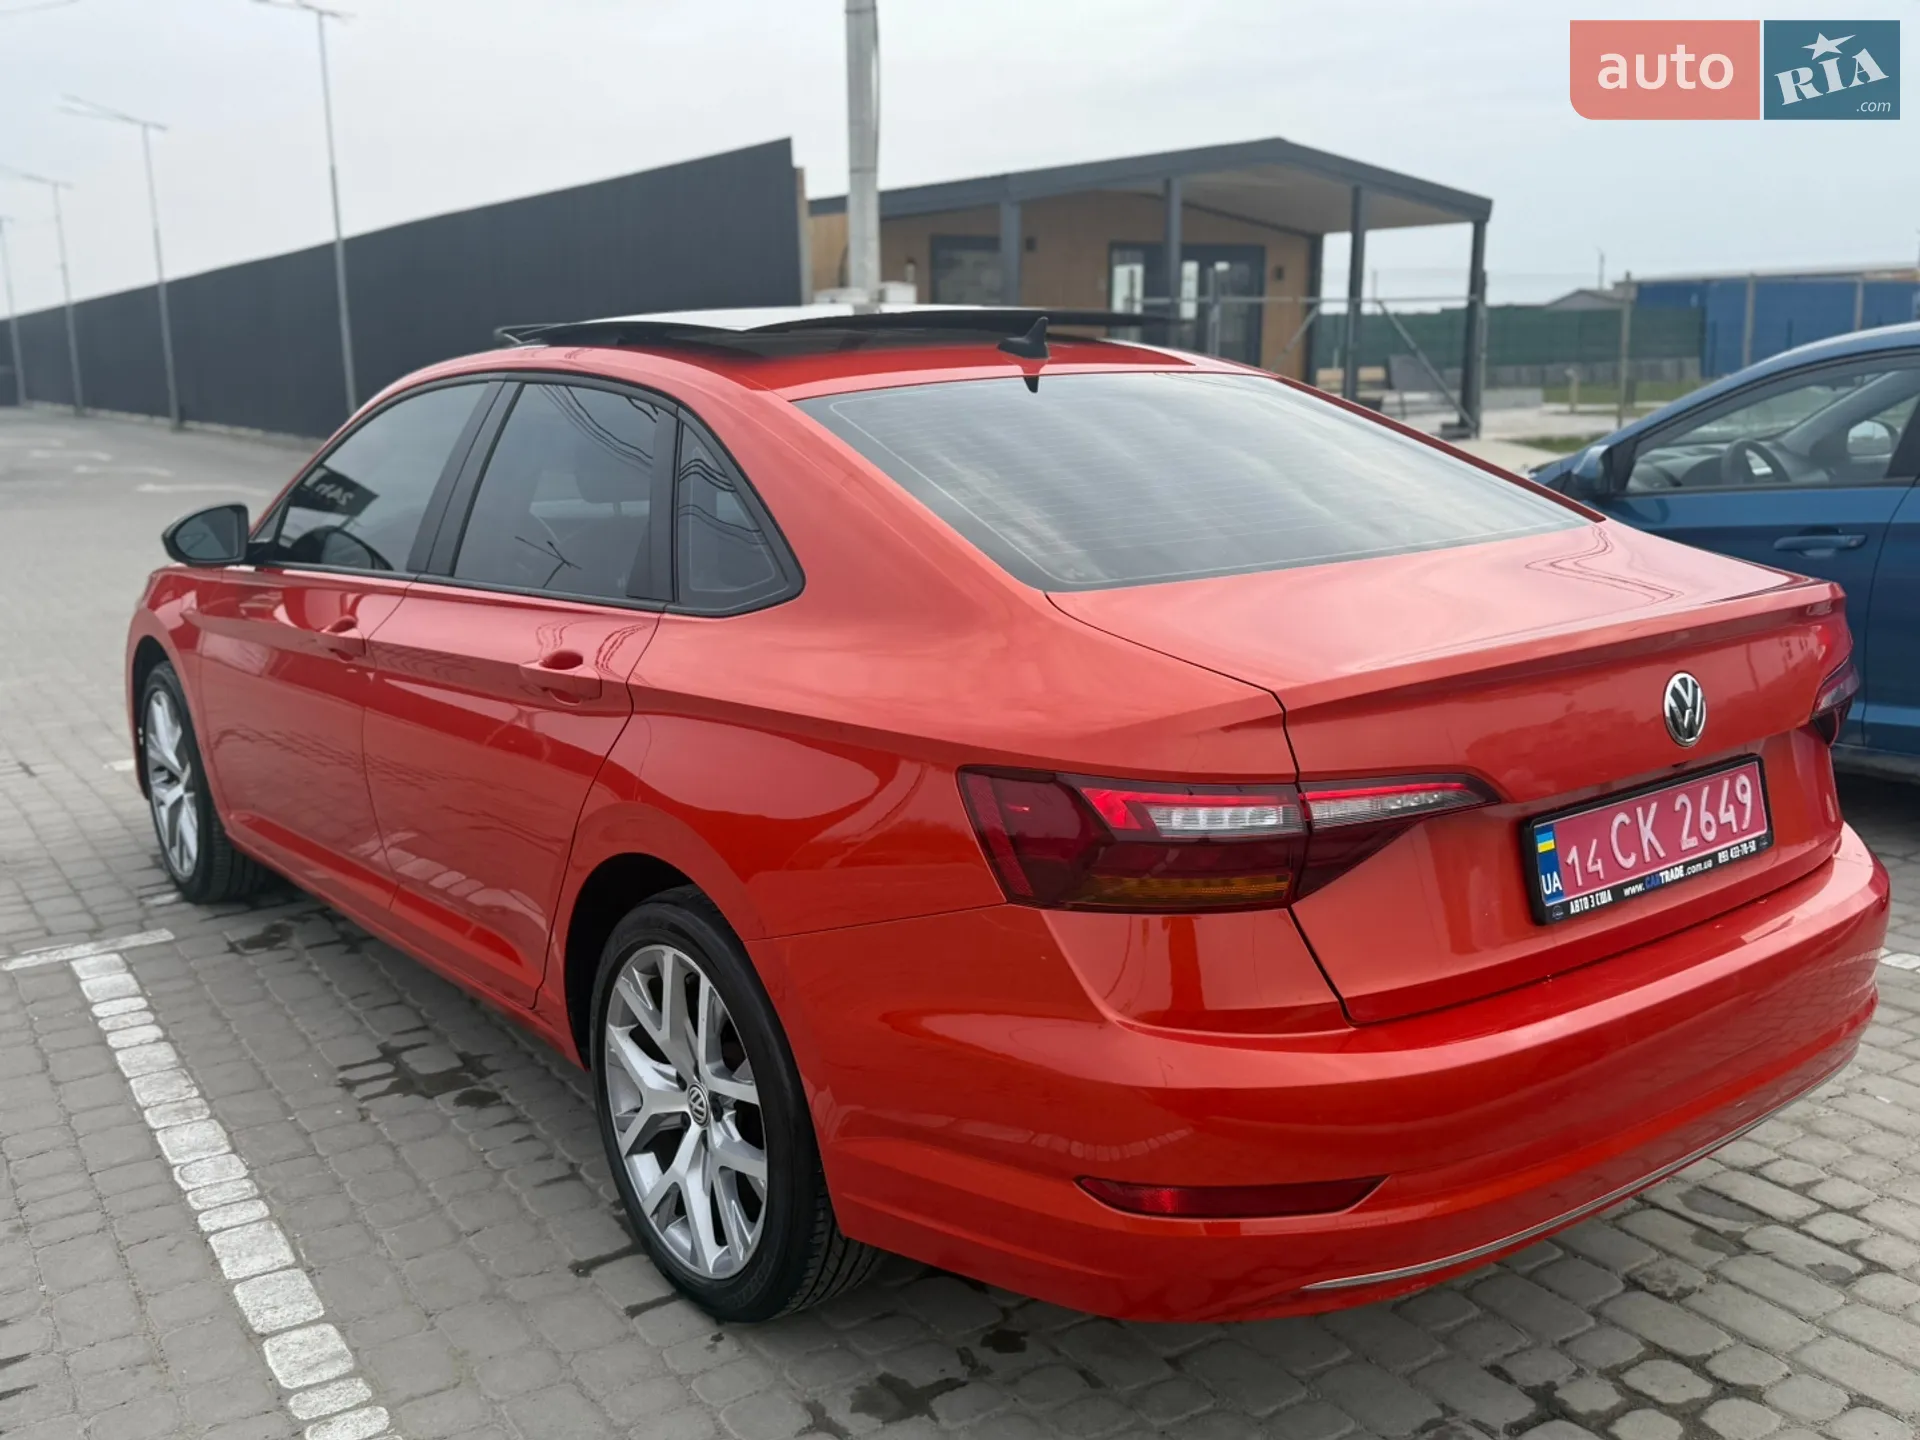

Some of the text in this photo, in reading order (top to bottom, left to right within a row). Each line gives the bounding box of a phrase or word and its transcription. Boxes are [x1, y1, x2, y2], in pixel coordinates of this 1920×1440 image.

[1565, 774, 1752, 887] 14 CK 2649
[1541, 871, 1563, 895] UA
